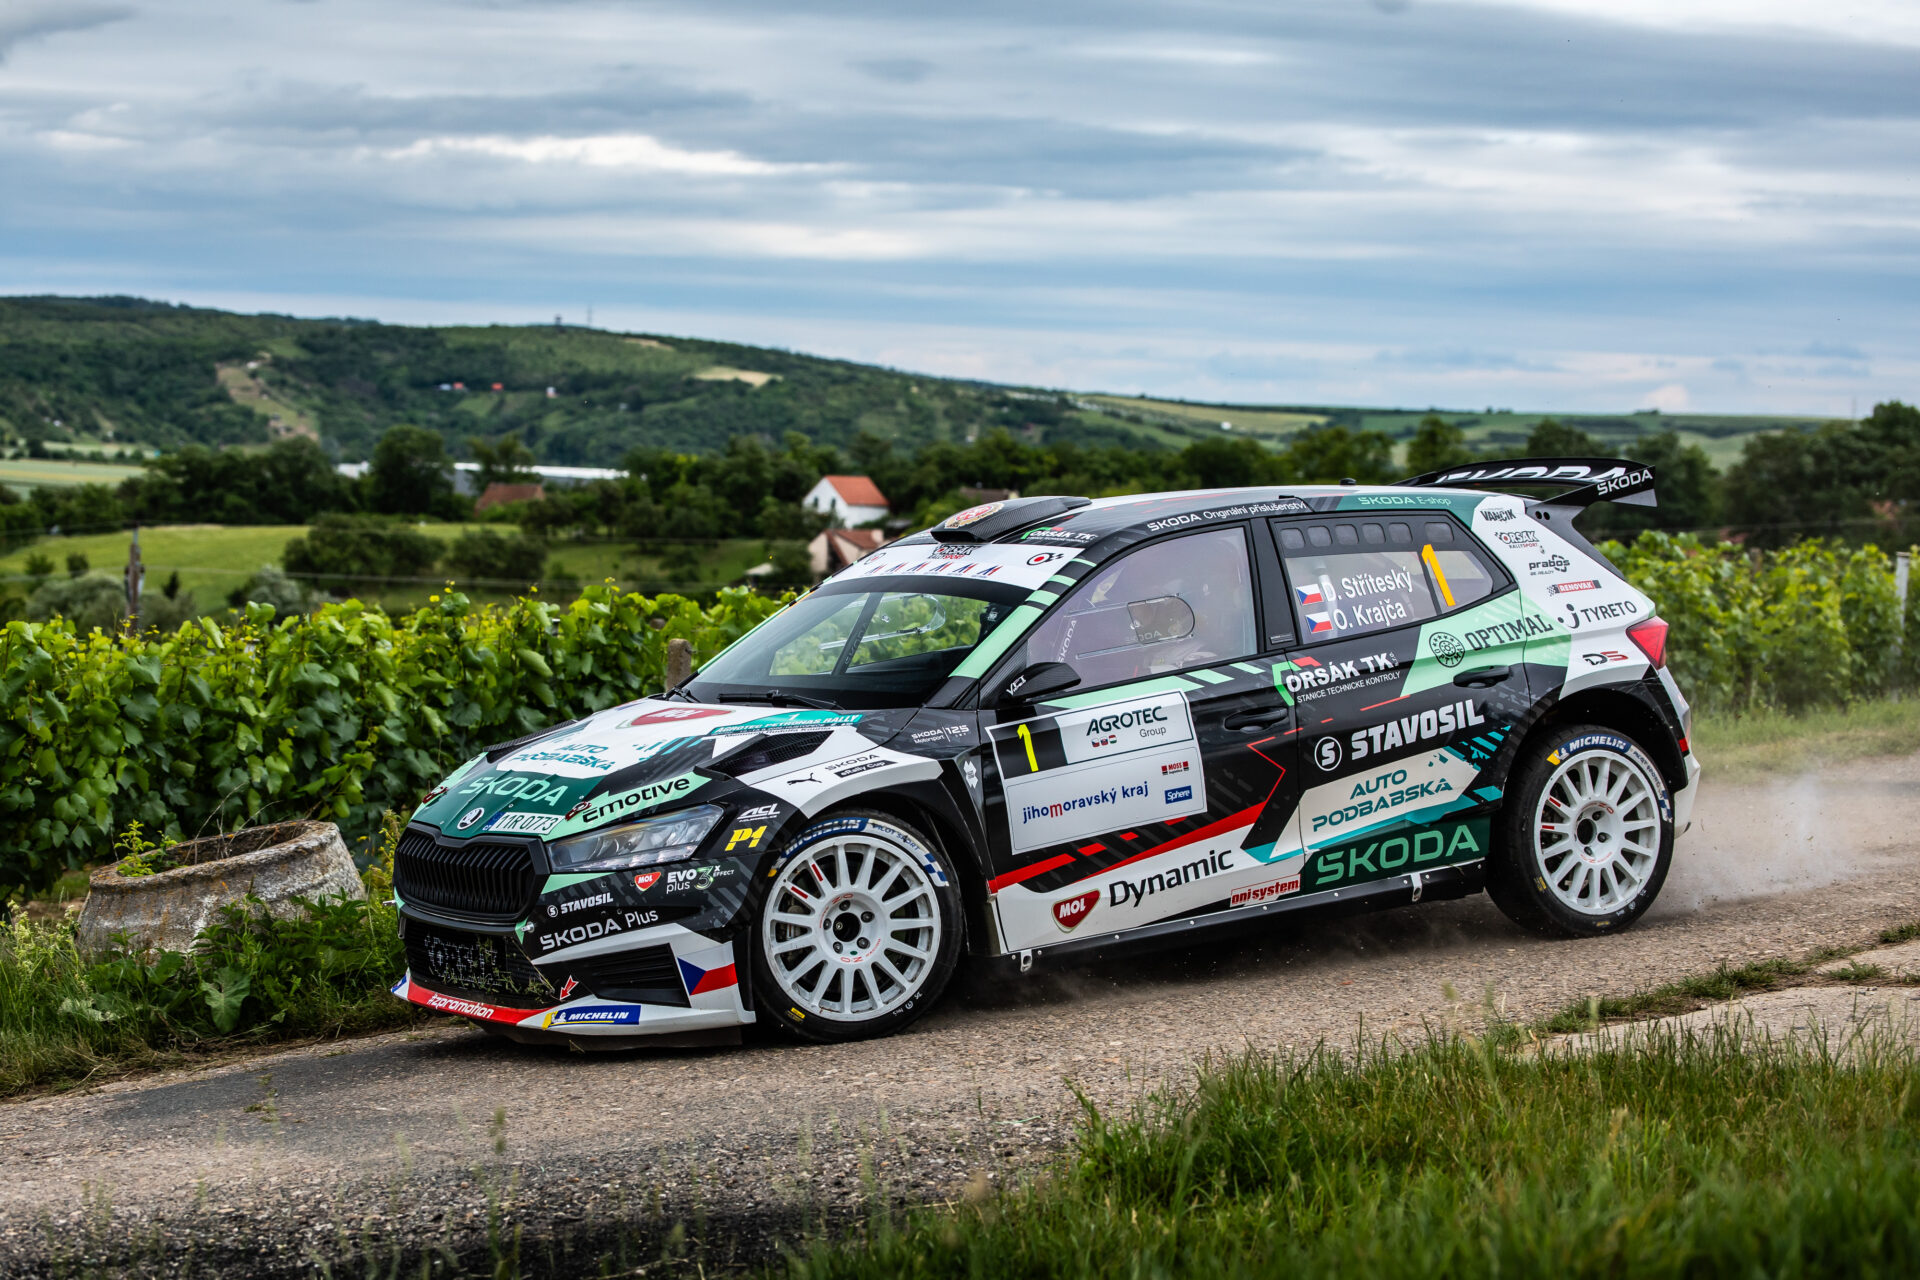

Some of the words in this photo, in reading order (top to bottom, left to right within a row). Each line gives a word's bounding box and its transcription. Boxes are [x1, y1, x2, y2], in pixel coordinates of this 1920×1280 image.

[1529, 558, 1571, 570] prabos
[1322, 582, 1342, 601] D.
[1342, 566, 1413, 598] Stříteský
[1421, 544, 1456, 607] 1
[1559, 582, 1593, 592] RENOVAK
[1333, 609, 1354, 630] O.
[1355, 600, 1407, 627] Krajča
[1580, 601, 1638, 623] TYRETO
[1464, 614, 1554, 651] OPTIMAL
[1286, 661, 1360, 692] ORSÁK
[1360, 652, 1394, 673] TK
[1297, 689, 1326, 703] STANICE
[1366, 670, 1400, 687] KONTROLY
[823, 714, 859, 723] RALLY
[1086, 705, 1168, 736] AGROTEC
[914, 735, 946, 744] Motorsport
[946, 724, 970, 735] 125
[1140, 725, 1167, 739] Group
[1351, 699, 1485, 761] STAVOSIL
[1017, 724, 1039, 772] 1
[1569, 736, 1627, 752] MICHELIN
[840, 765, 867, 777] eRally
[867, 761, 887, 772] Cup
[1168, 762, 1182, 770] MOSS
[1350, 769, 1408, 800] AUTO
[1022, 787, 1117, 824] jihomoravský
[1122, 781, 1149, 800] kraj
[1167, 790, 1190, 802] Sphere
[520, 815, 559, 831] 0773
[725, 825, 768, 851] P1
[638, 875, 653, 884] MOL
[667, 868, 697, 883] EVO
[713, 869, 734, 877] EFFECT
[1109, 849, 1234, 908] Dynamic
[666, 880, 690, 894] plus
[560, 892, 614, 914] STAVOSIL
[1059, 897, 1086, 919] MOL
[624, 907, 659, 928] Plus
[568, 1009, 630, 1021] MICHELIN
